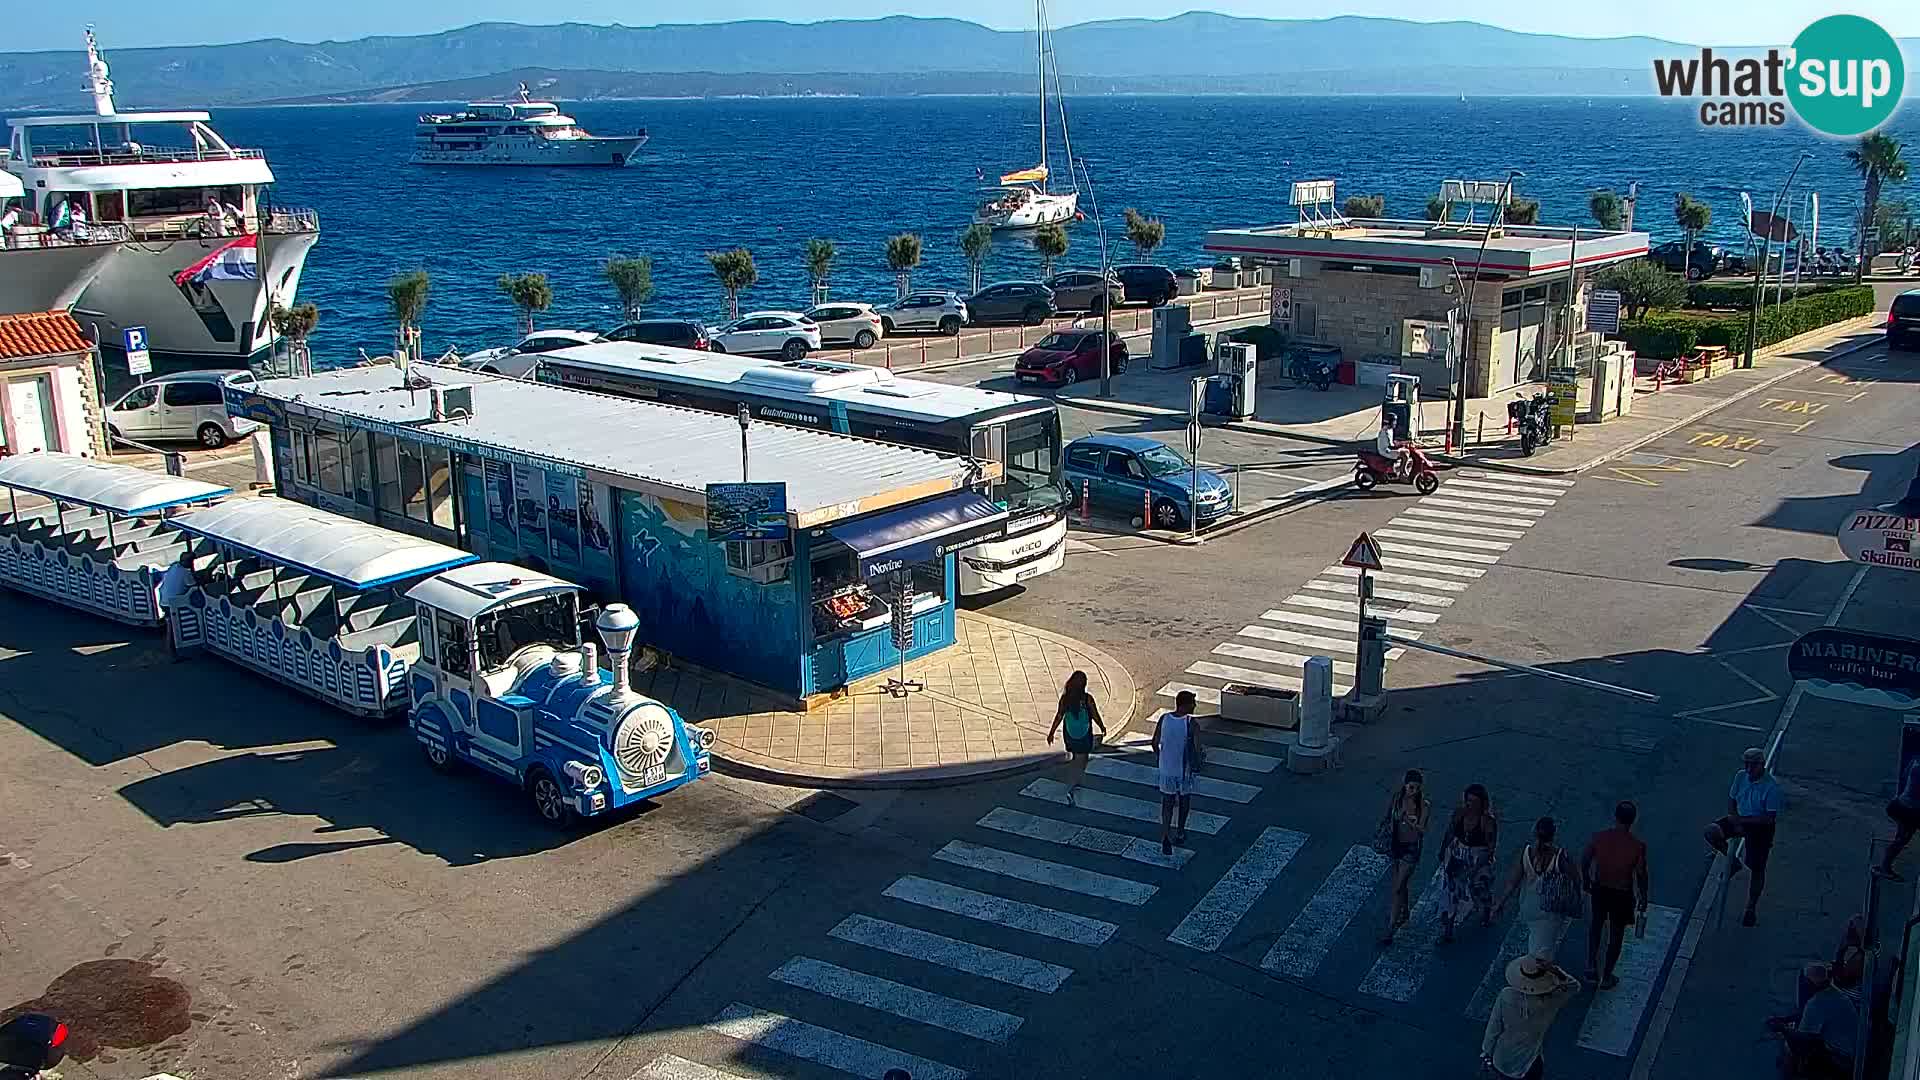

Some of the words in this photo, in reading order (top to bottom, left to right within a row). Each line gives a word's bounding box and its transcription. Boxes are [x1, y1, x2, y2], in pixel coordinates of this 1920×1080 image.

[1759, 398, 1830, 414] TAXI
[436, 437, 468, 452] POSTAJA
[1687, 432, 1764, 451] TAXI
[478, 446, 493, 458] BUS
[493, 449, 526, 465] STATION
[527, 456, 554, 471] TICKET
[555, 463, 583, 478] OFFICE
[1848, 515, 1920, 533] PIZZE
[1011, 540, 1042, 557] IVECO
[1871, 665, 1896, 680] bar
